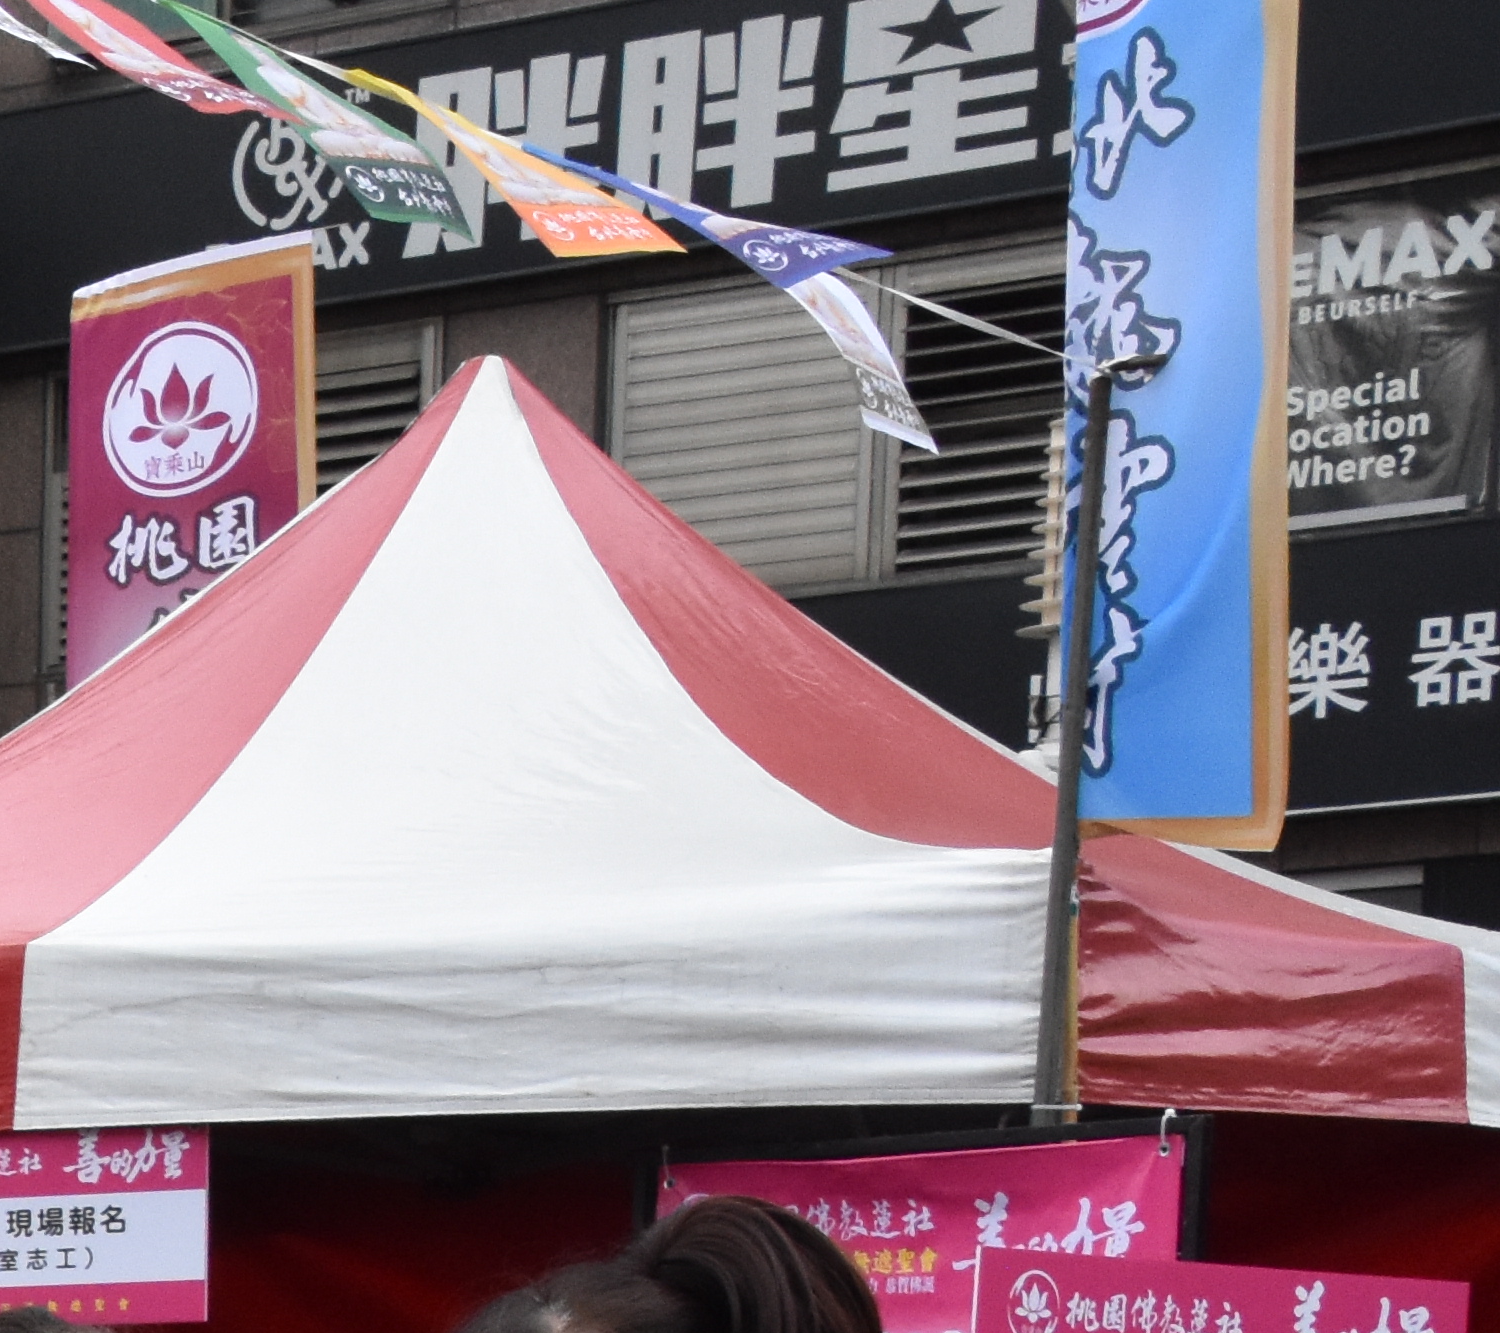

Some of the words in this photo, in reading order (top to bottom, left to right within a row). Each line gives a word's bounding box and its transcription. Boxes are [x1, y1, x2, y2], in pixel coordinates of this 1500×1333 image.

[403, 0, 1076, 258] 胖胖星
[1287, 368, 1420, 421] Special
[1288, 410, 1430, 452] ocation
[63, 1130, 192, 1184] 善的力量
[784, 1199, 935, 1240] 佛教蓮社
